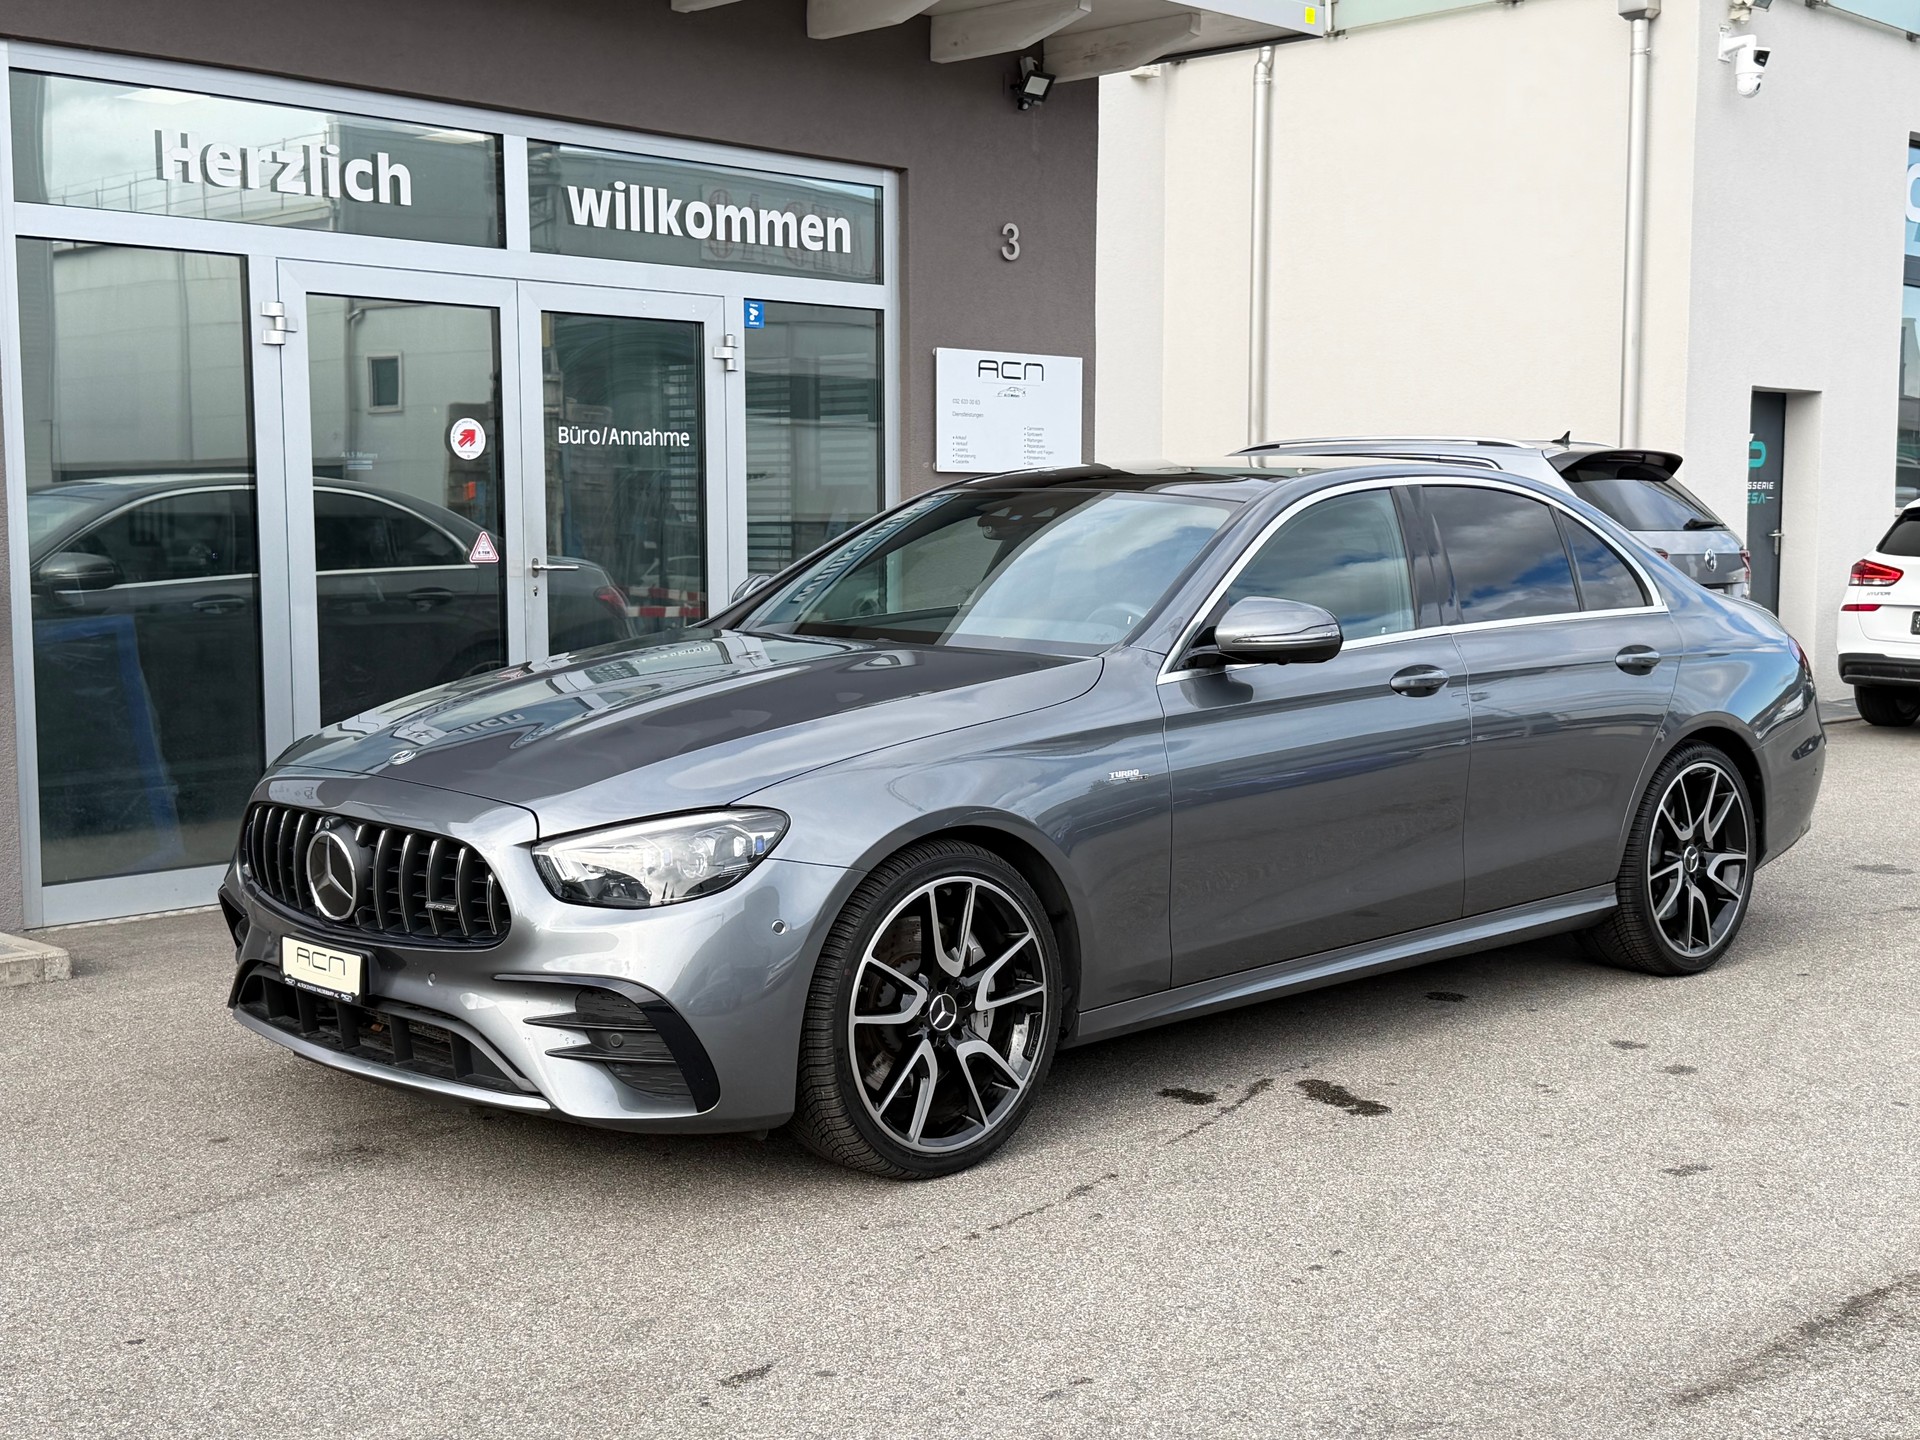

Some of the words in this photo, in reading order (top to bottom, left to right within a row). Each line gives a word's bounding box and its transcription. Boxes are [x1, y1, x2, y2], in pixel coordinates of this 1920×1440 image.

[160, 128, 413, 207] Herzlich
[567, 180, 851, 254] willkommen
[1001, 222, 1021, 261] 3
[558, 426, 690, 447] Büro/Annahme
[1109, 769, 1140, 778] TURBO
